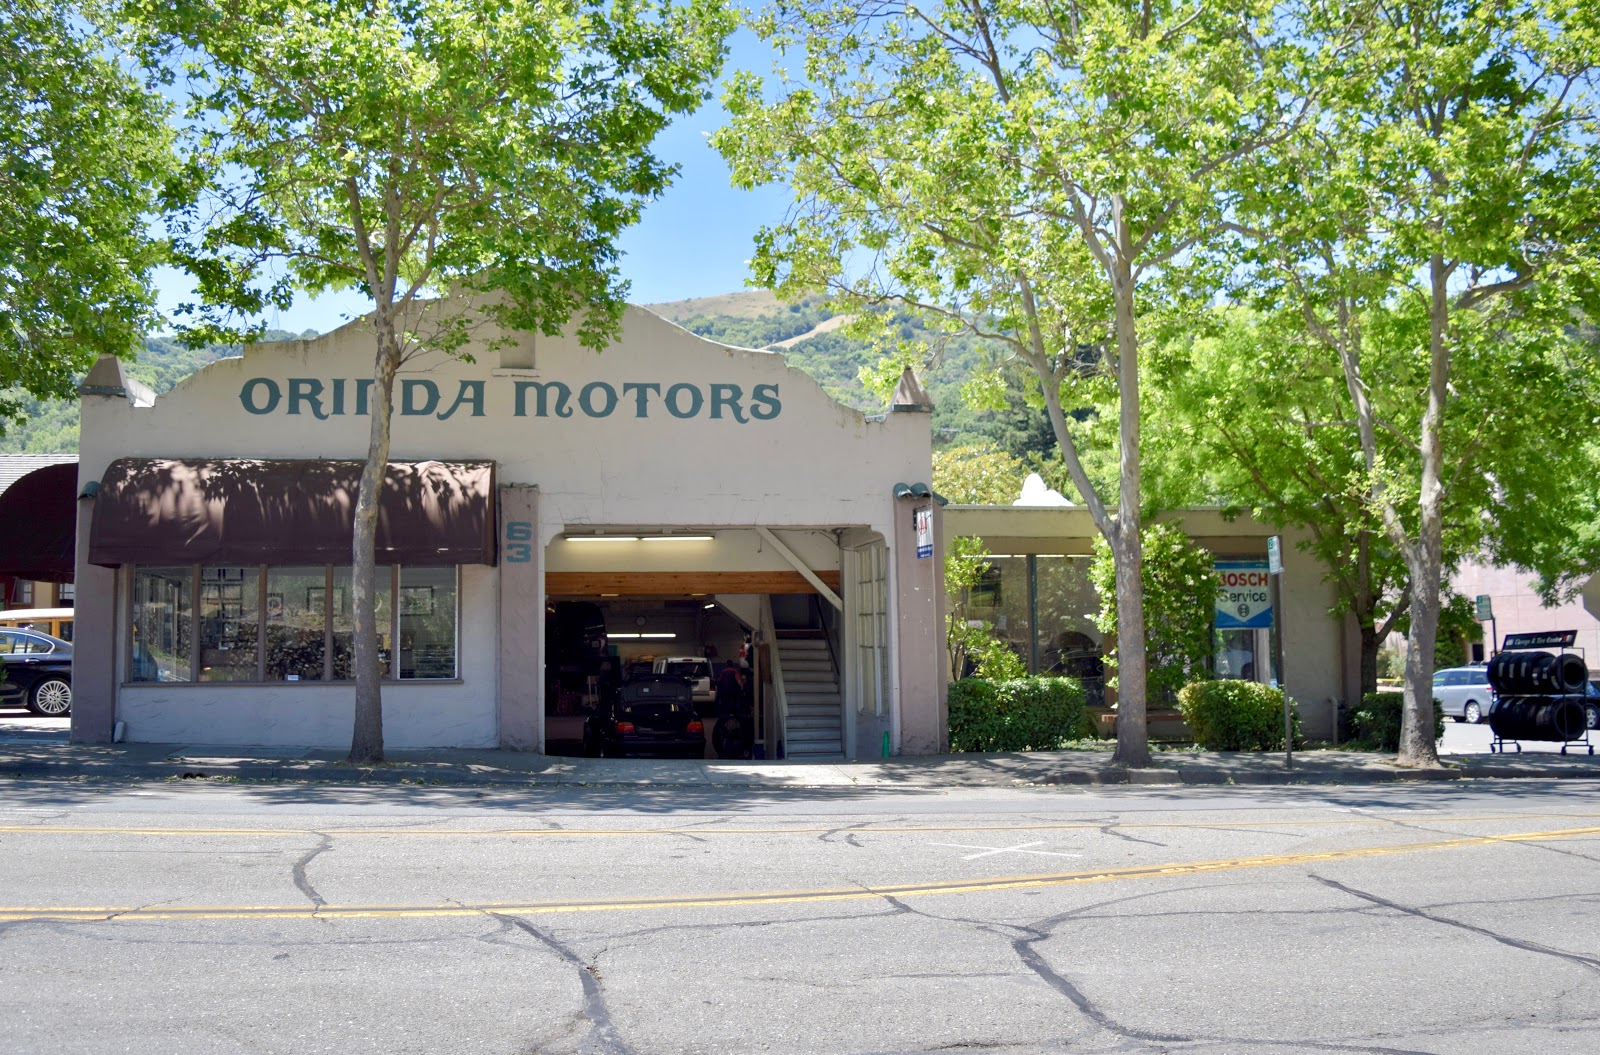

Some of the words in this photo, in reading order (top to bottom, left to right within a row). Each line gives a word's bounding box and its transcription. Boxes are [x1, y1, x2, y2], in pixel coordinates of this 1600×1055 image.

[513, 381, 782, 424] MOTORS
[1218, 572, 1269, 587] BOSCH
[1219, 589, 1267, 602] Service
